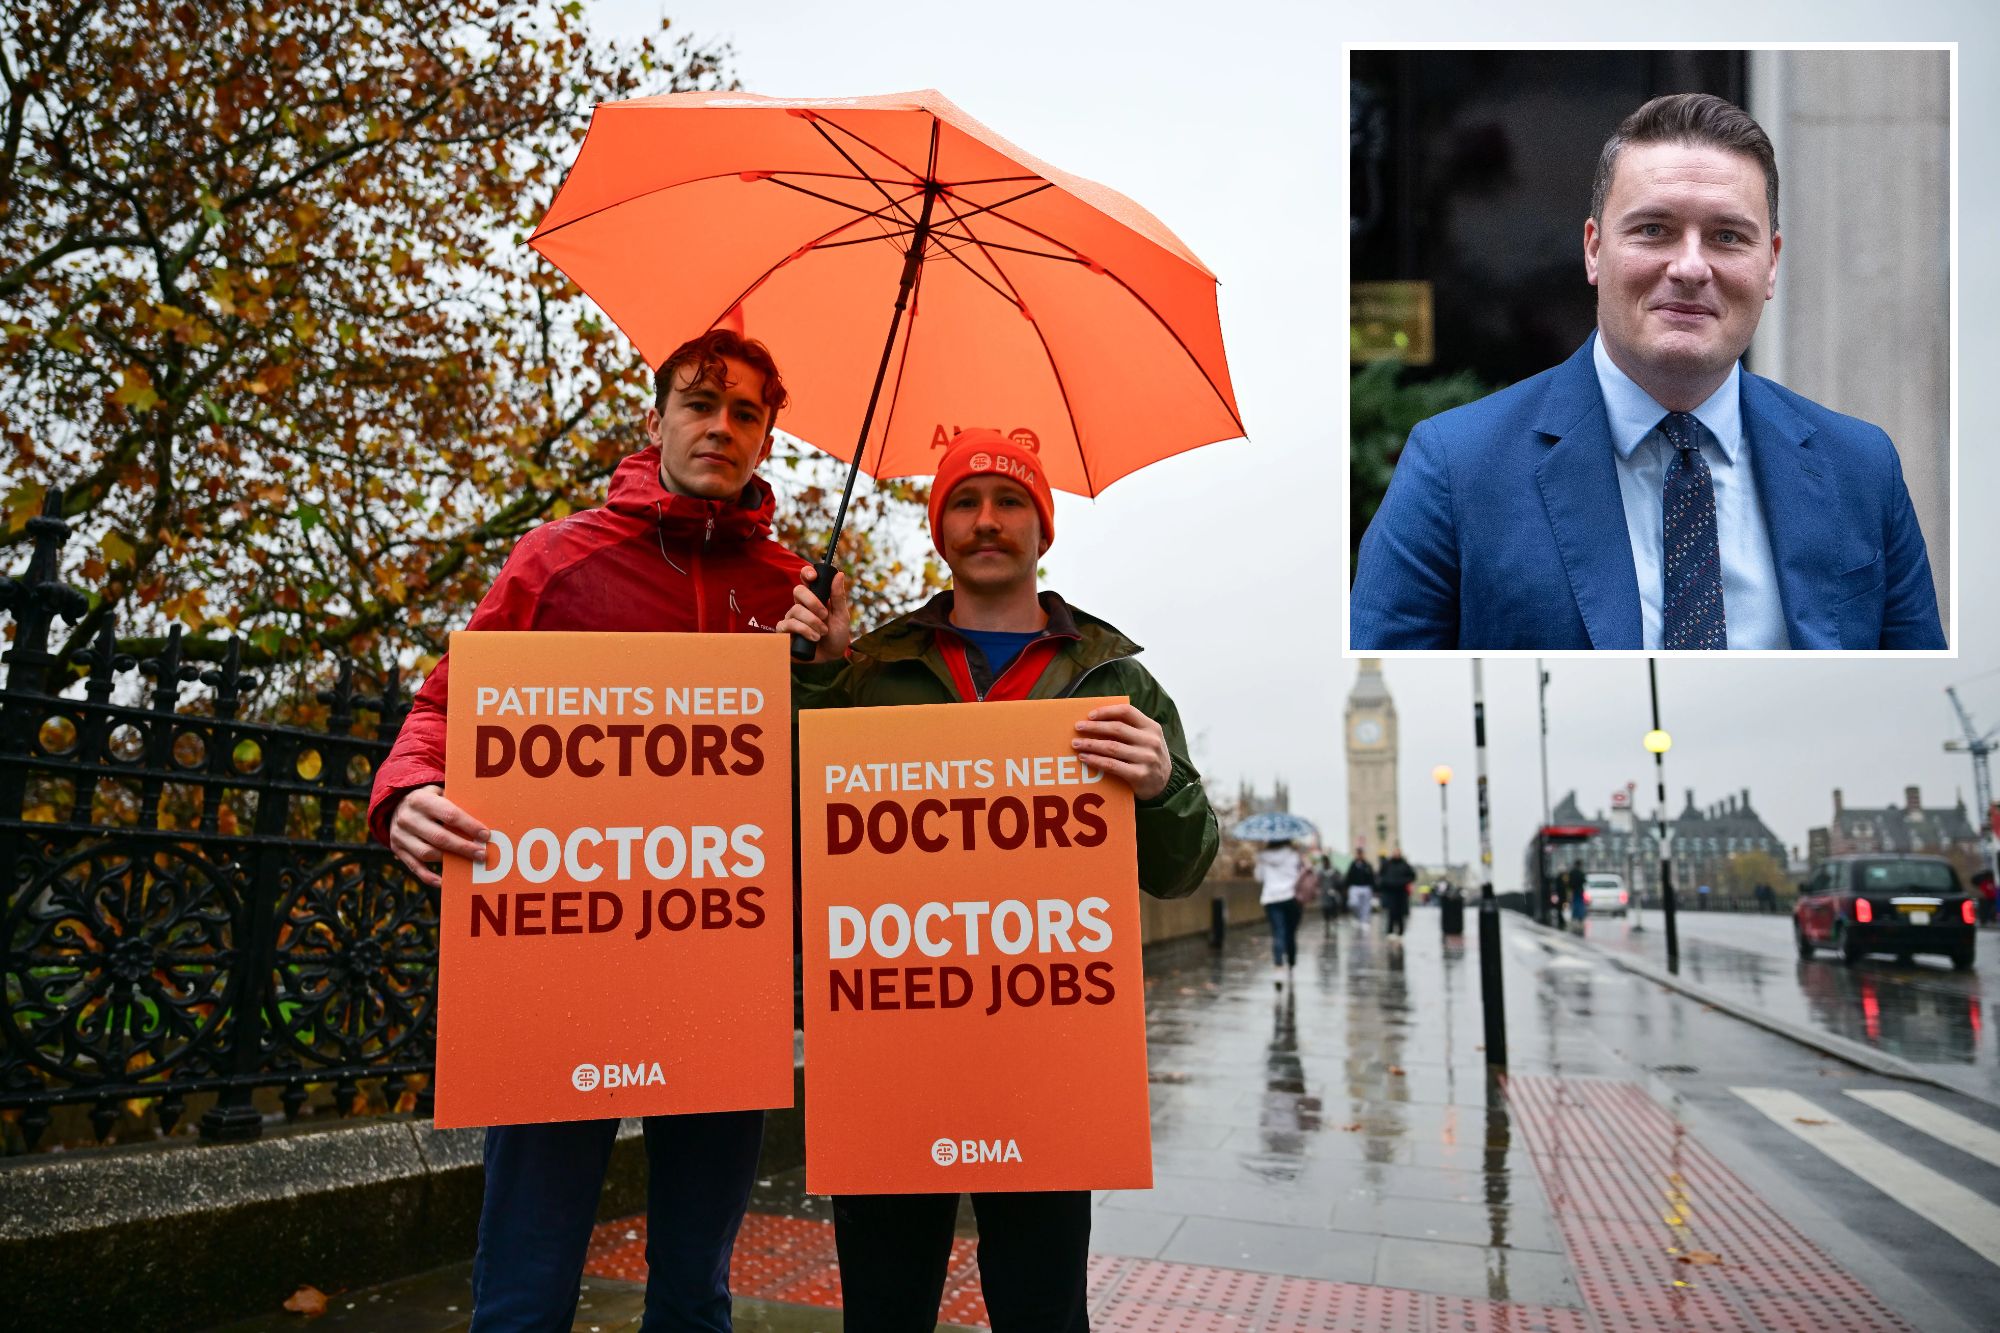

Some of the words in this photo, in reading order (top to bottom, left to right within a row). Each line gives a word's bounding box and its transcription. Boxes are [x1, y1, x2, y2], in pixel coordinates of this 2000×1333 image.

[995, 455, 1035, 486] BMA
[476, 686, 654, 716] PATIENTS
[665, 687, 765, 715] NEED
[475, 724, 765, 778] DOCTORS
[825, 759, 995, 793] PATIENTS
[1005, 756, 1104, 786] NEED
[826, 793, 1108, 855] DOCTORS
[472, 824, 766, 884] DOCTORS
[470, 891, 623, 938] NEED
[634, 887, 766, 940] JOBS
[828, 897, 1113, 960] DOCTORS
[829, 966, 974, 1012] NEED
[985, 962, 1116, 1016] JOBS
[603, 1062, 666, 1089] BMA
[961, 1139, 1023, 1164] BMA
